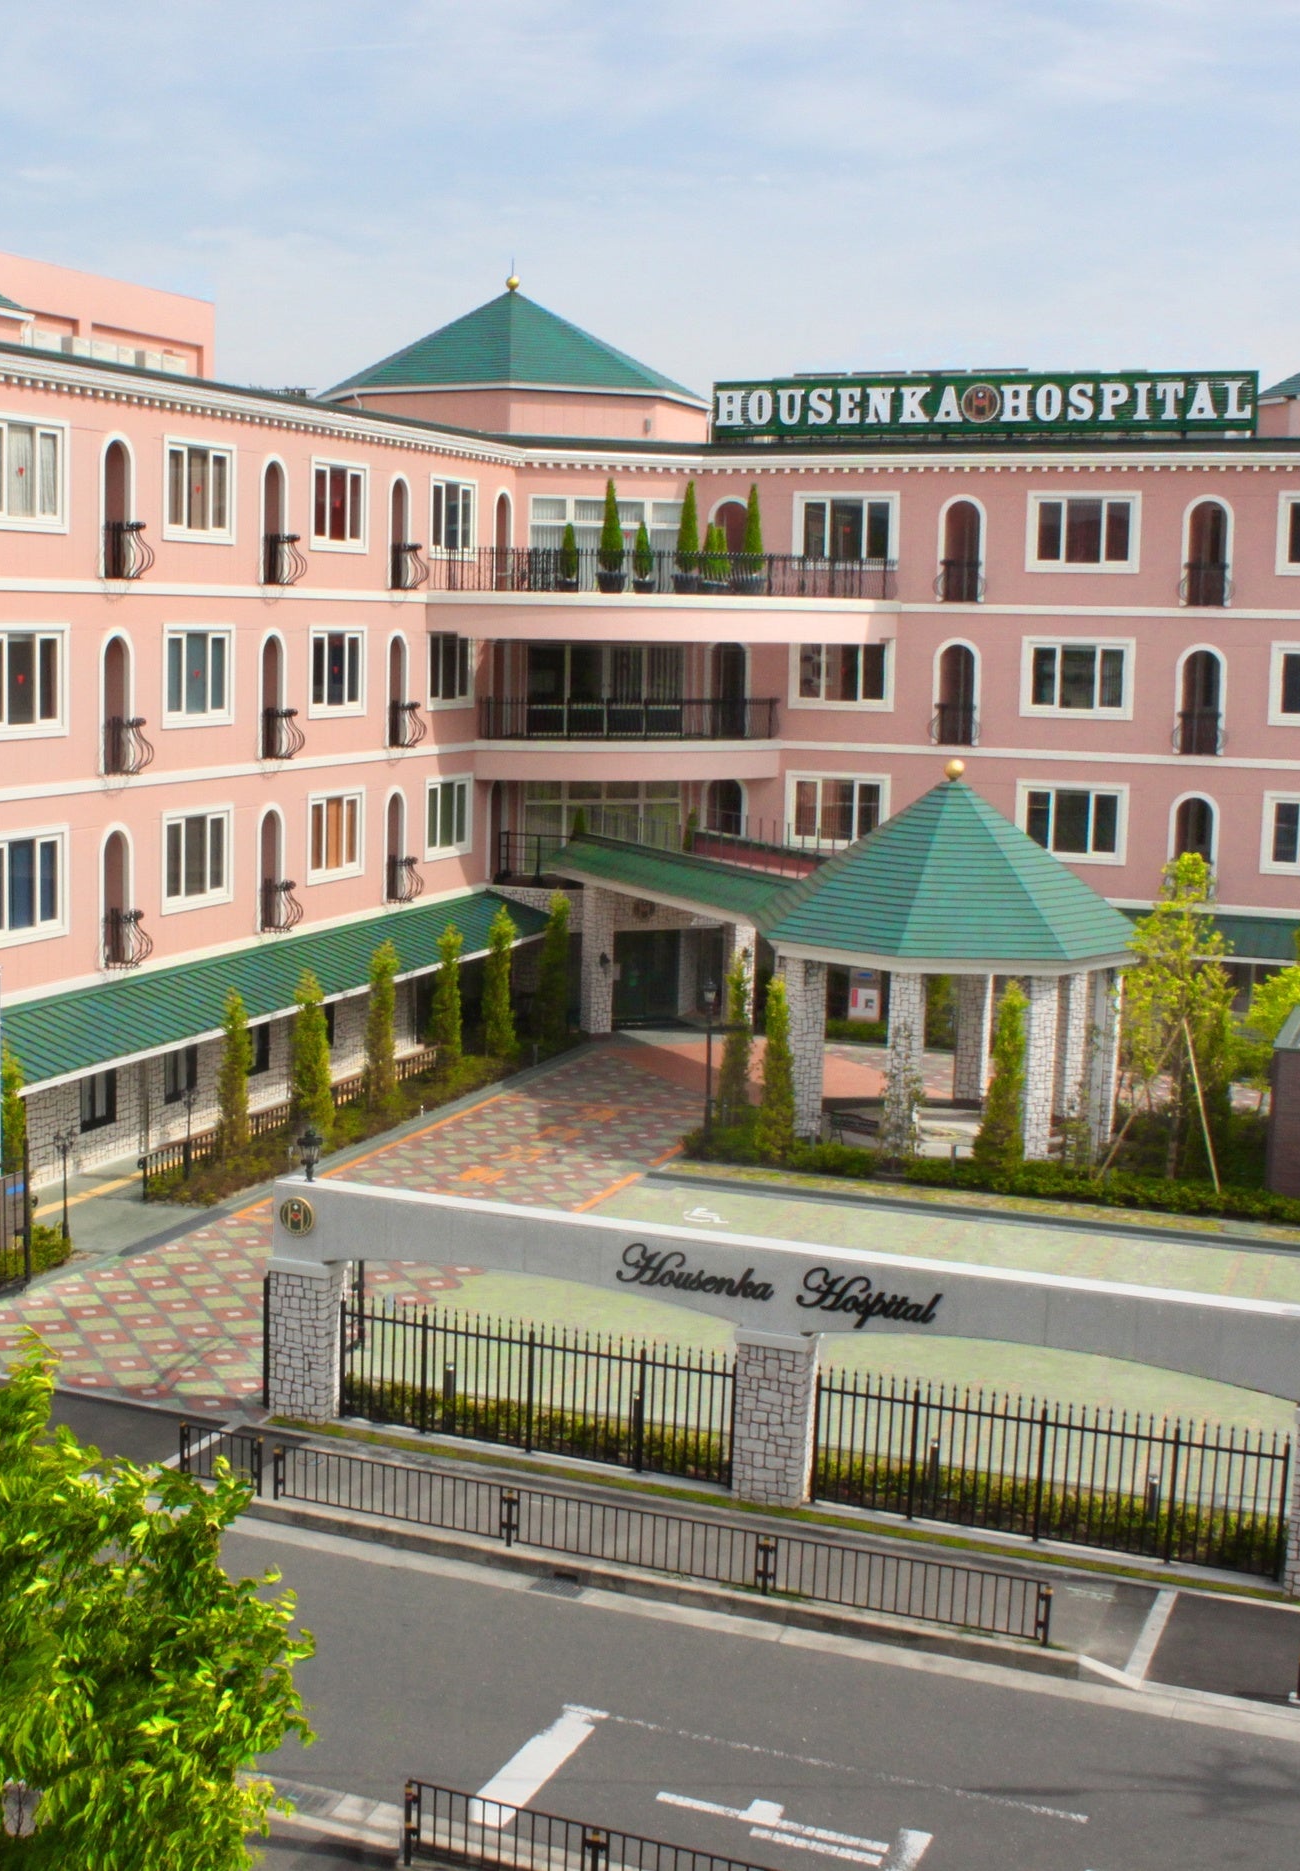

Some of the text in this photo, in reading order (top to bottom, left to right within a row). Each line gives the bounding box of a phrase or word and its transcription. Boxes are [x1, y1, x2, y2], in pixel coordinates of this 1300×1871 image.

[715, 381, 1252, 427] HOUSENKA HOSPITAL
[616, 1242, 943, 1329] Housenka Hospital
